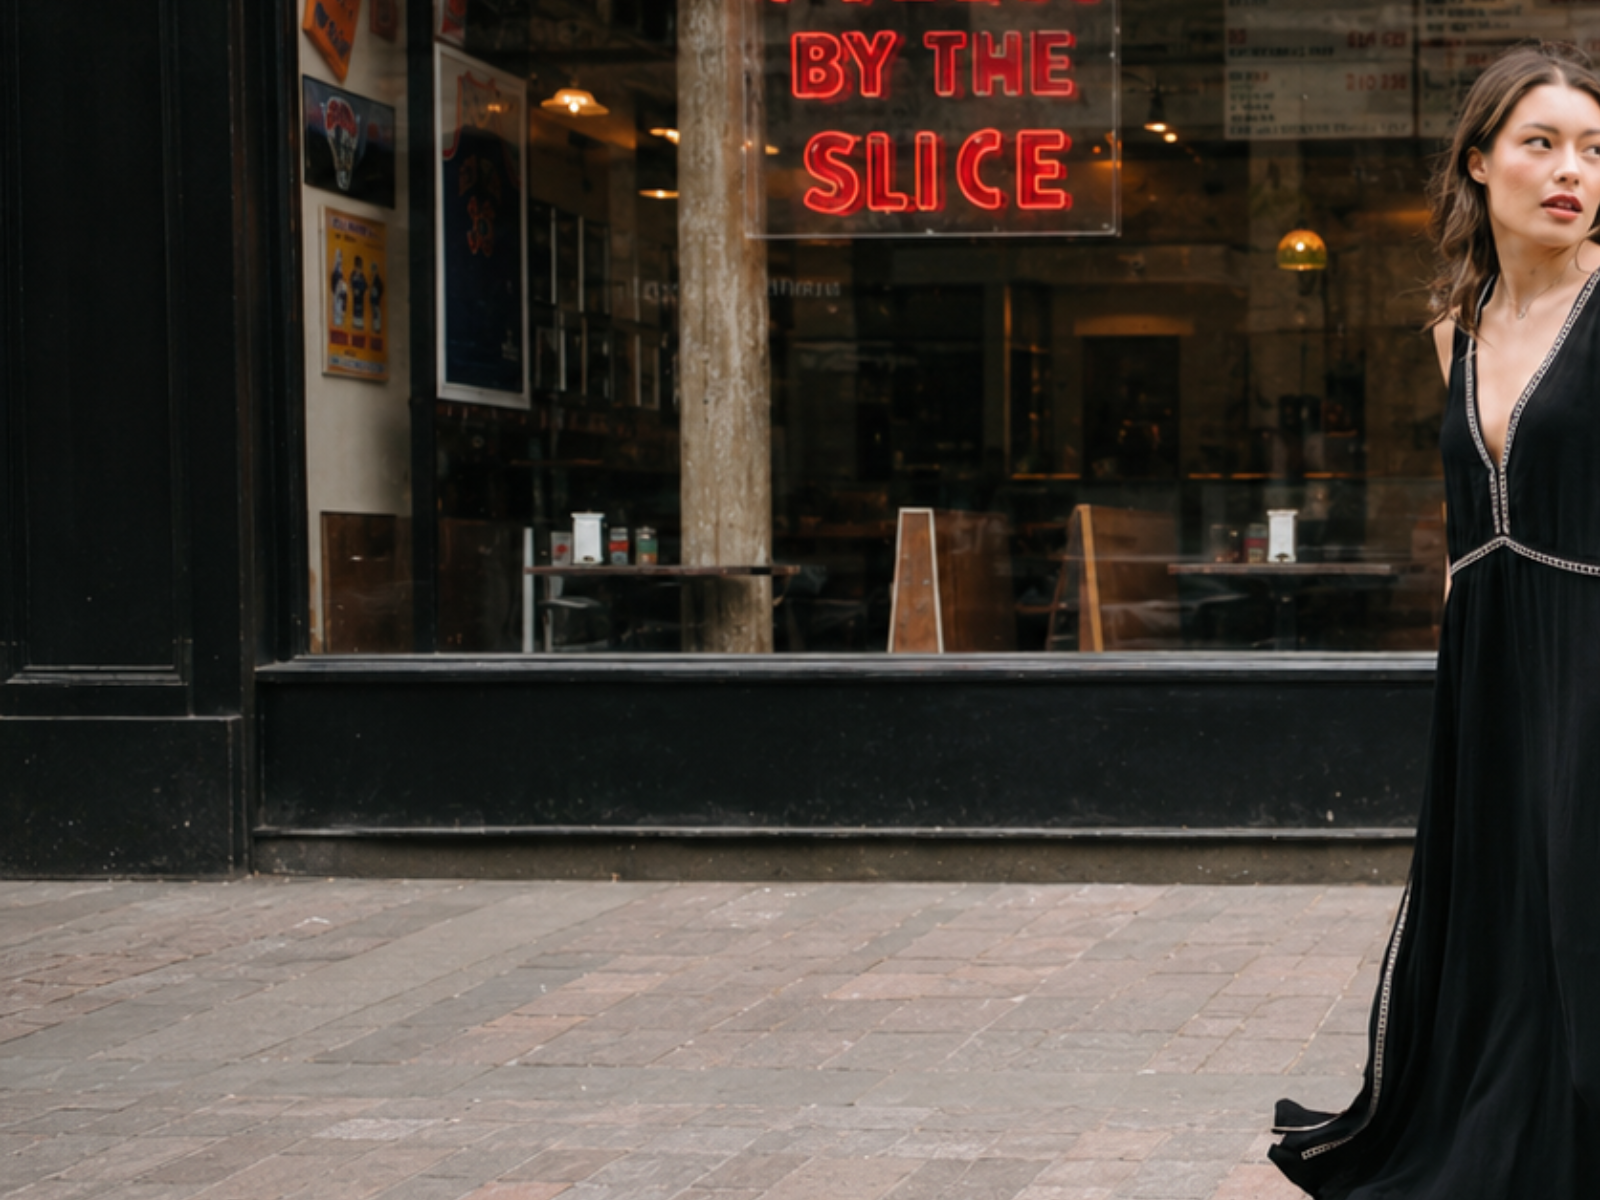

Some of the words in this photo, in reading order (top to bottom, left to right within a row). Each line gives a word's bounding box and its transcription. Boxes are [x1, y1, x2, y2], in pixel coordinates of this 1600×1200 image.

[791, 30, 900, 99] BY
[923, 30, 1075, 97] THE
[803, 127, 1072, 215] SLICE
